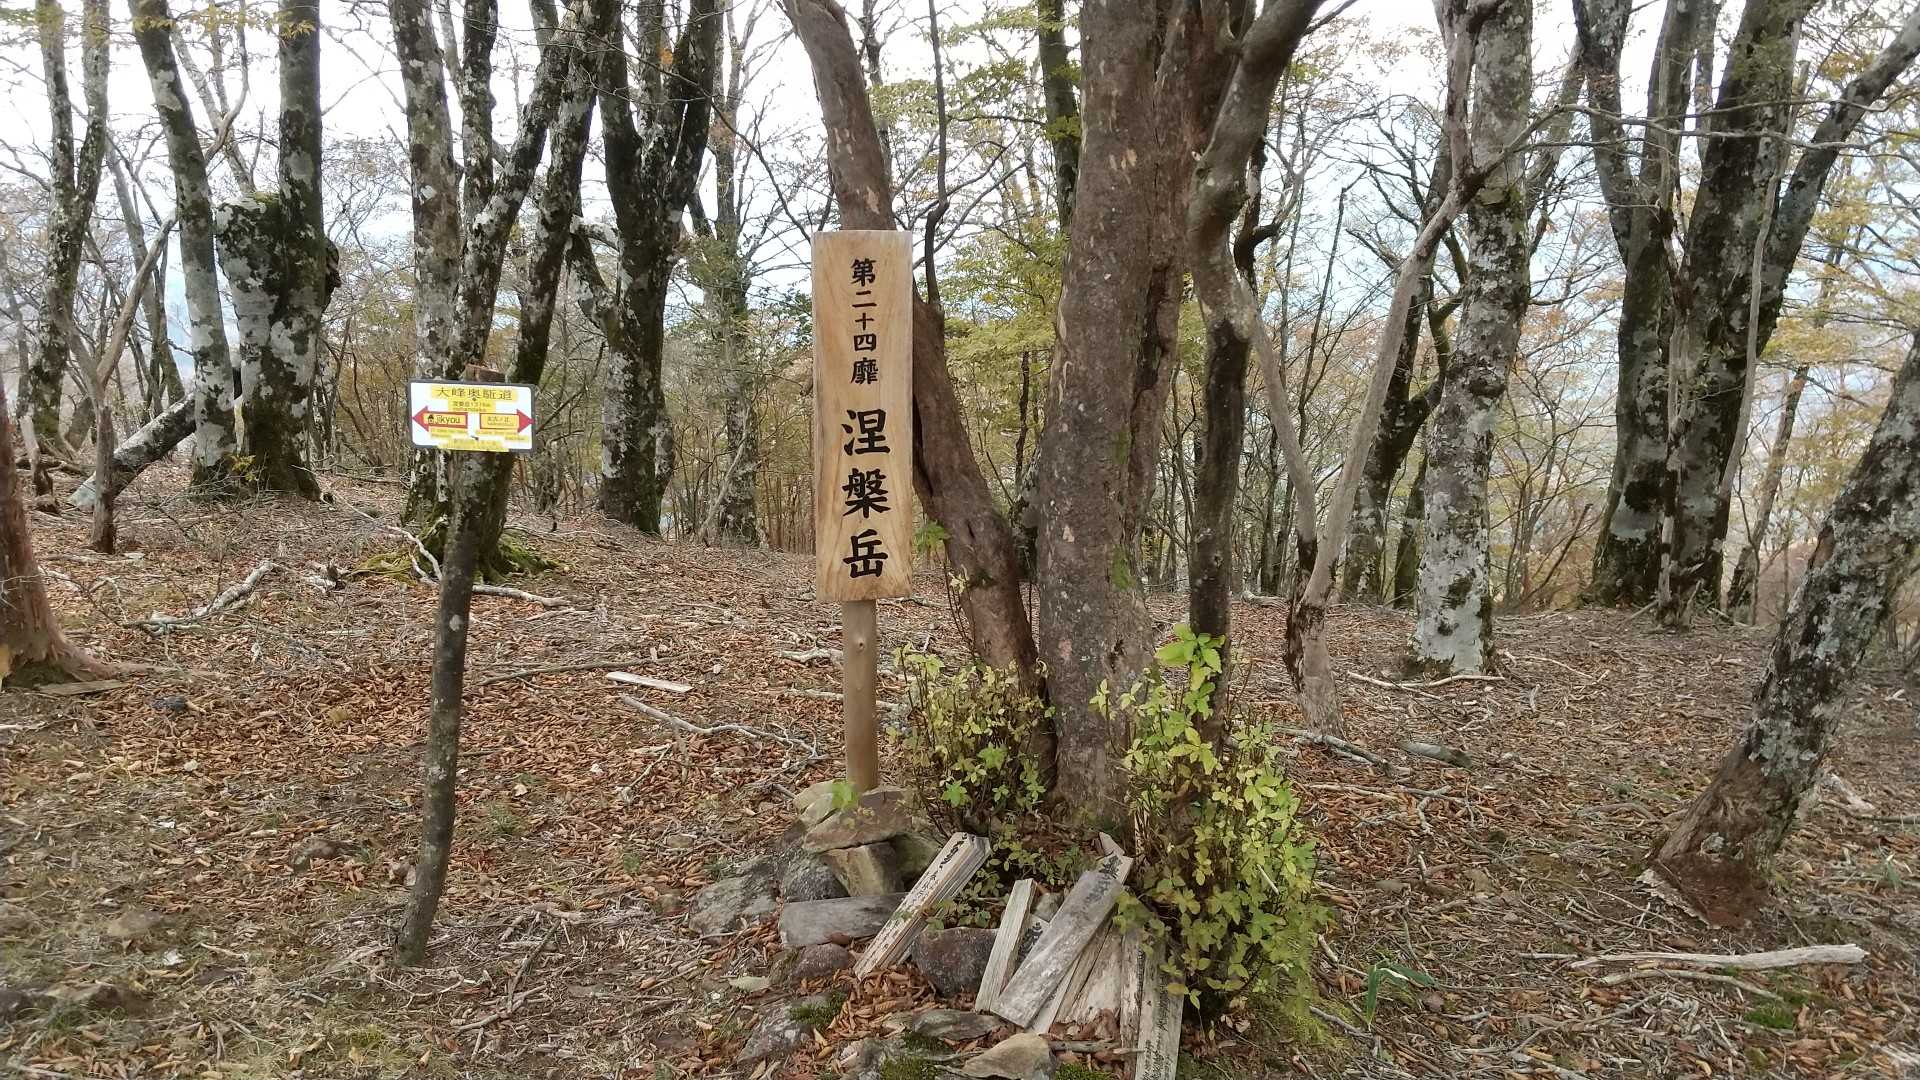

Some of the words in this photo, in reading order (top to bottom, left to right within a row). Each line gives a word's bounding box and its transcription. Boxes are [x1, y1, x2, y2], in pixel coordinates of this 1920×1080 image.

[851, 258, 878, 384] 第二十四靡
[841, 409, 891, 579] 涅槃岳
